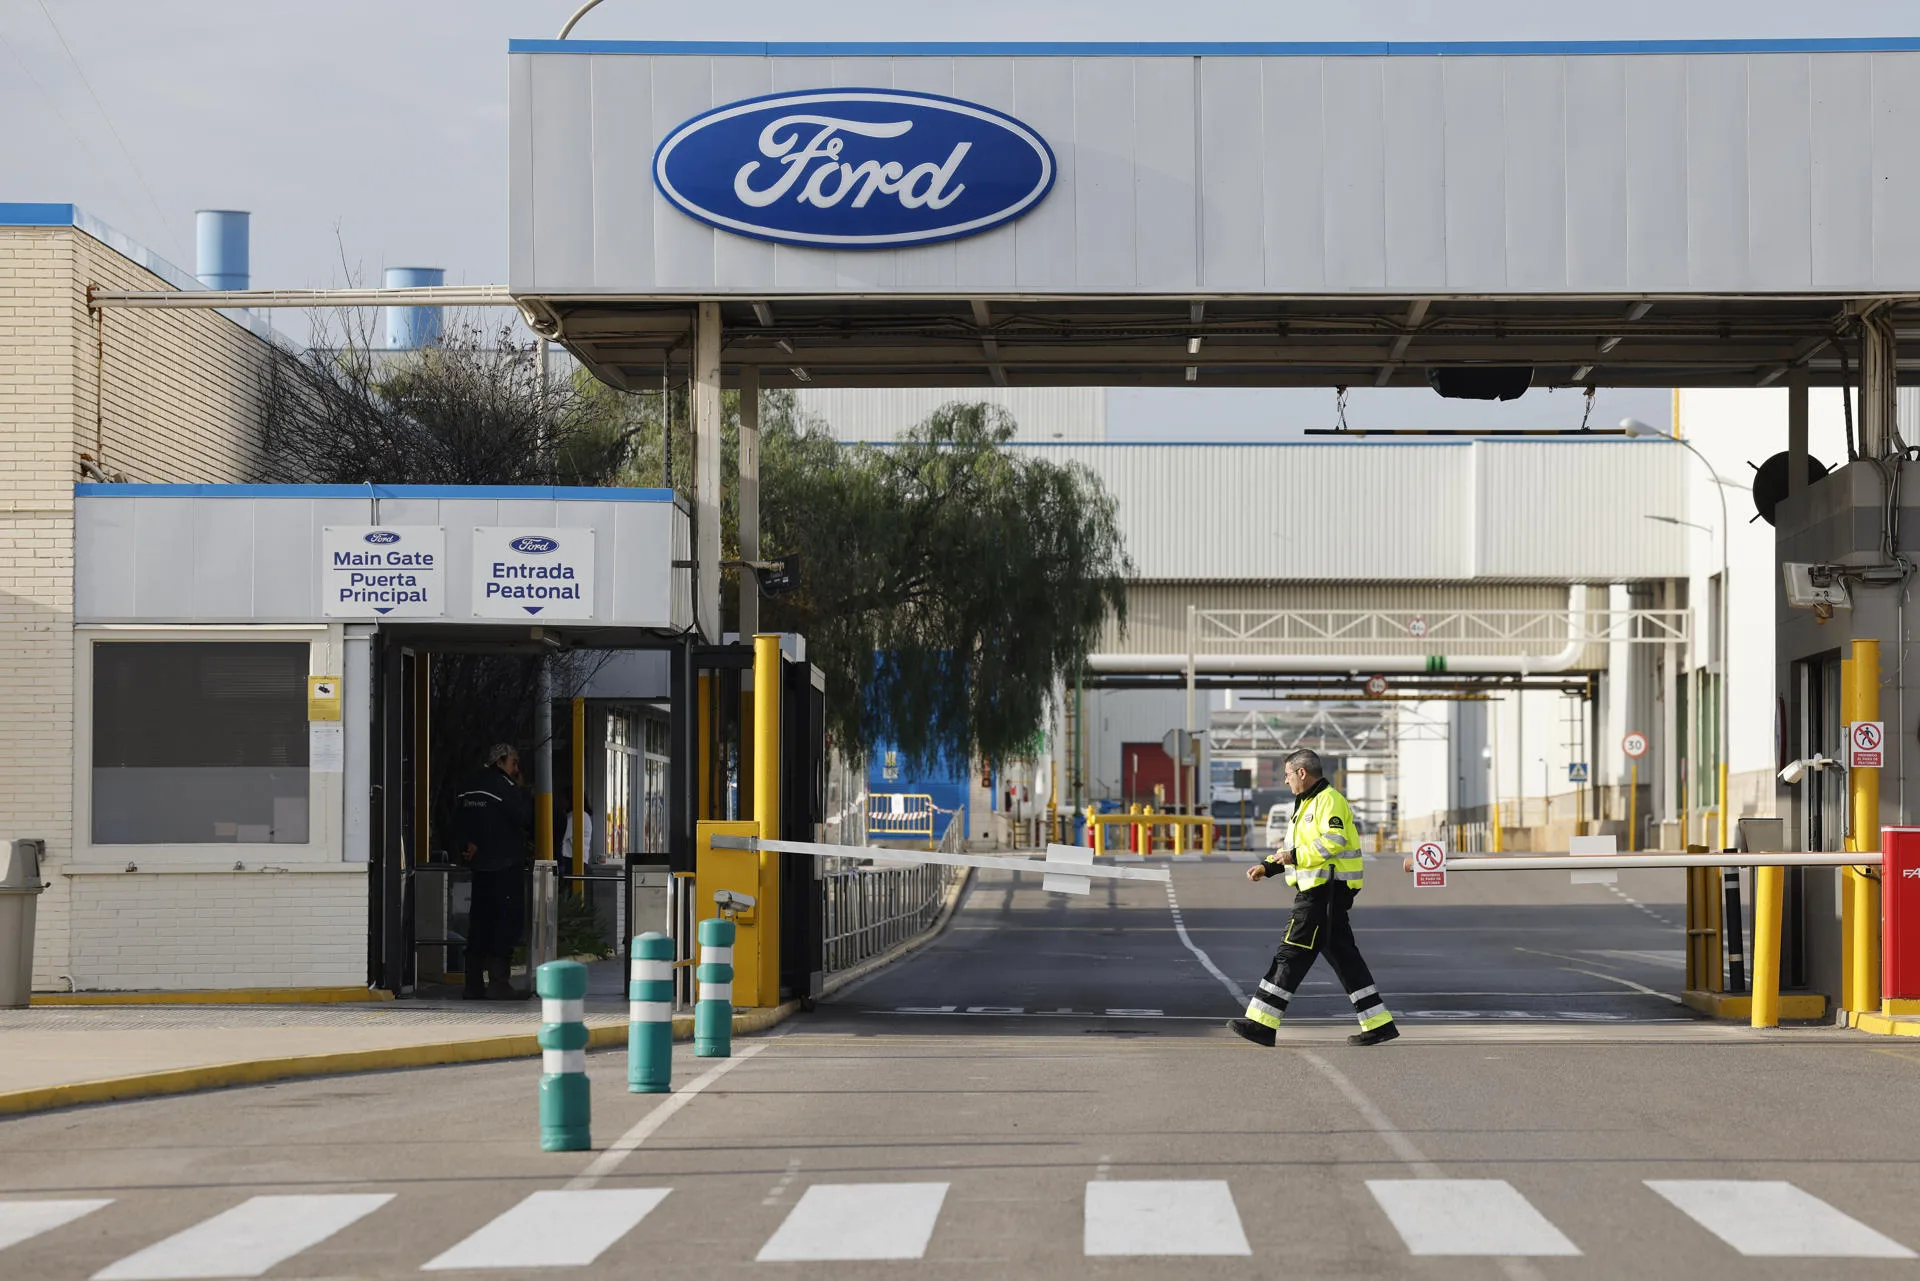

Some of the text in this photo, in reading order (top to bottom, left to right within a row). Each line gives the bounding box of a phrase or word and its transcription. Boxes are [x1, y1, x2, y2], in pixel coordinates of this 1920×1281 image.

[734, 115, 972, 209] Ford
[369, 532, 395, 544] Ford
[517, 538, 550, 552] Ford
[334, 552, 434, 566] Main Gate
[492, 562, 575, 580] Entrada
[351, 573, 417, 587] Puerta
[340, 588, 427, 604] Principal
[486, 583, 580, 600] Peatonal
[1627, 740, 1642, 751] 30
